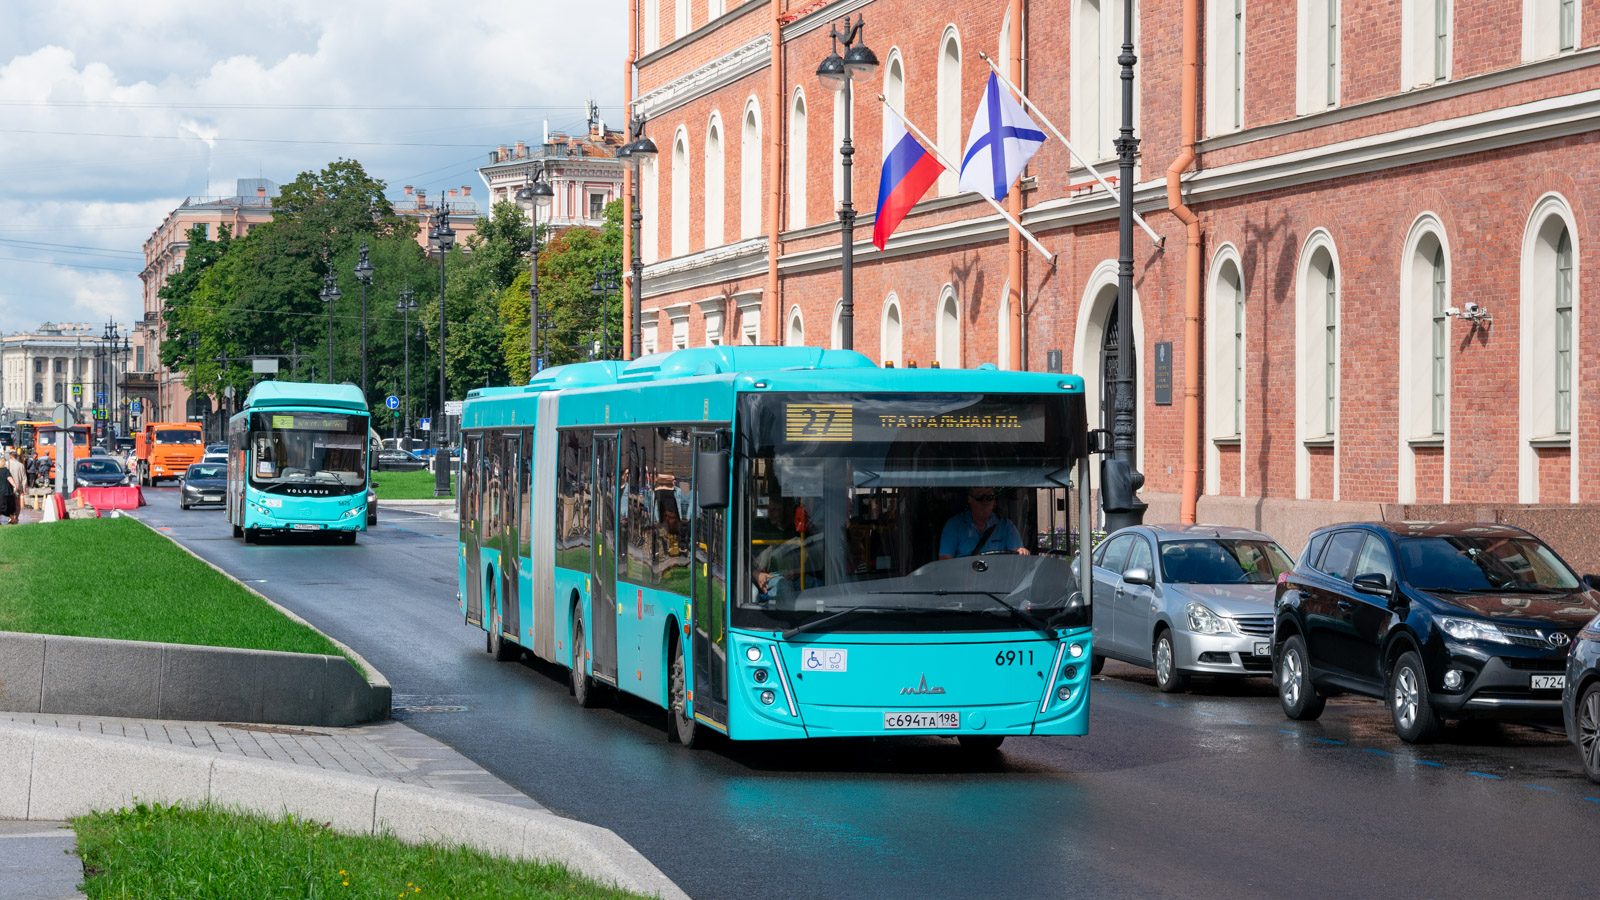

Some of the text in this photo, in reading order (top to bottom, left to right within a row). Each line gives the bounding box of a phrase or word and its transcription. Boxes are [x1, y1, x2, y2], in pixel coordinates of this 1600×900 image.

[801, 408, 836, 434] 27
[995, 650, 1033, 666] 6911
[939, 713, 956, 723] 198
